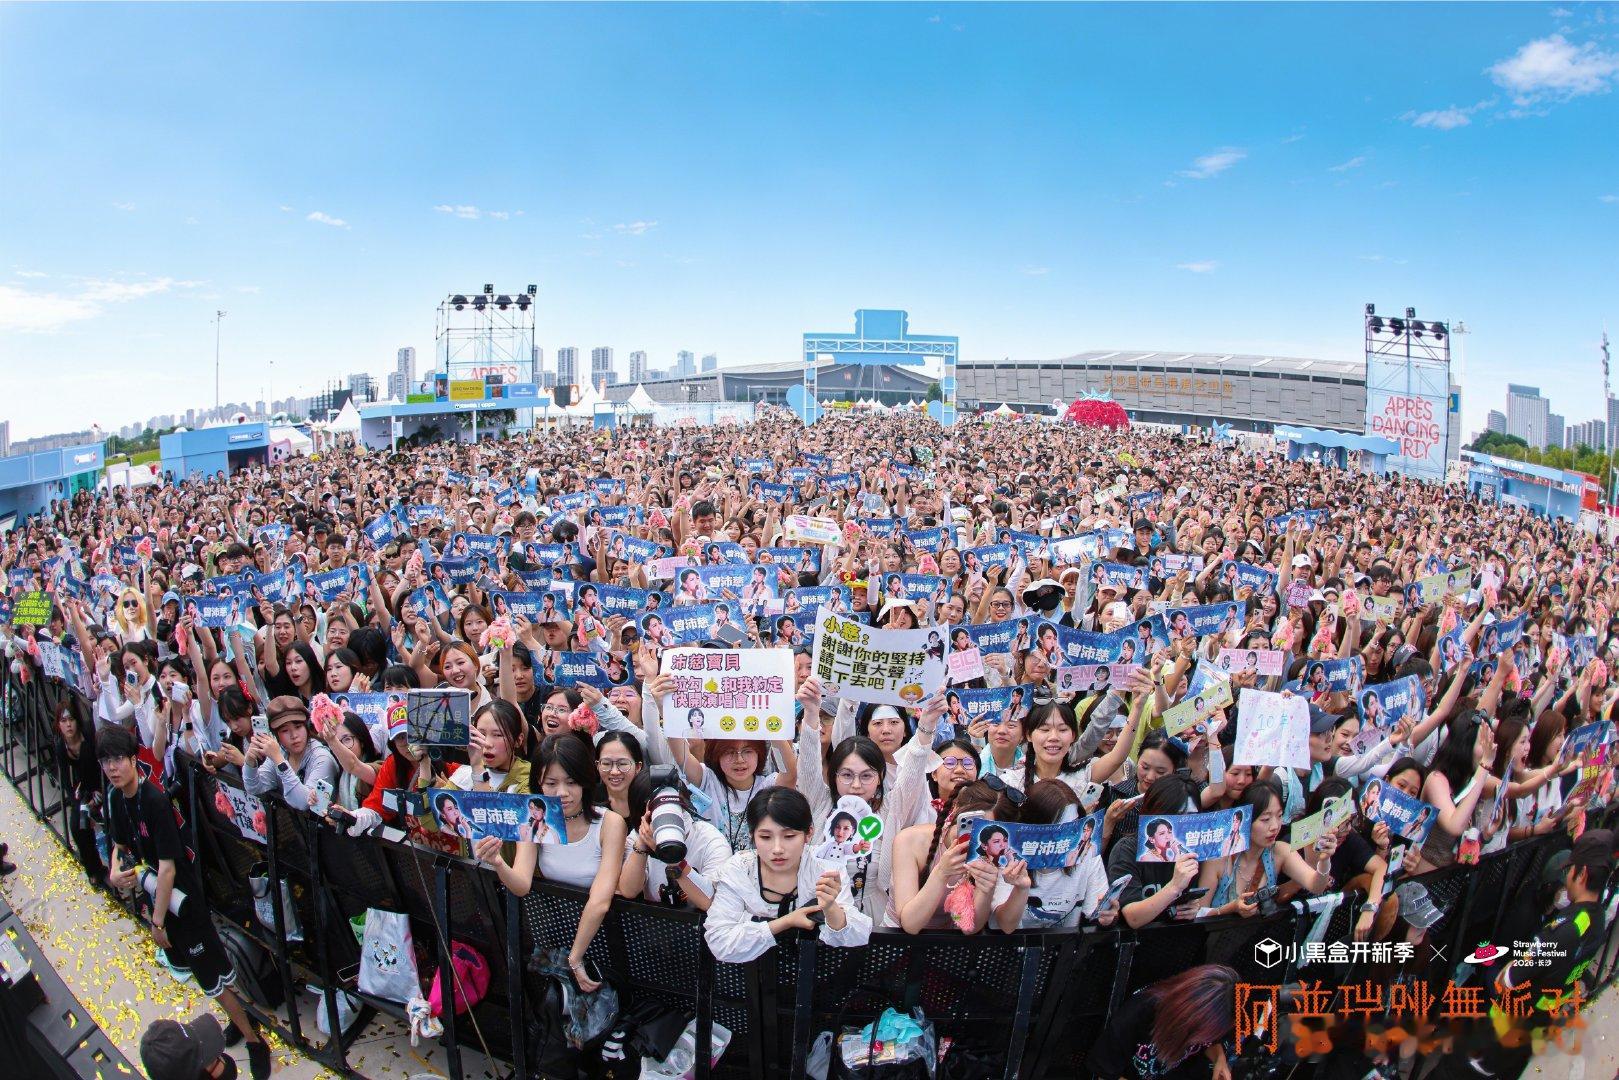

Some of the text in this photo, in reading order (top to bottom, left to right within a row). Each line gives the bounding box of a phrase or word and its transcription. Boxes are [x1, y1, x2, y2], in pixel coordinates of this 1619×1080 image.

[1385, 396, 1432, 421] APRÈS
[1373, 415, 1440, 442] DANCING
[1386, 436, 1431, 460] RTY
[709, 575, 744, 588] 曾沛慈
[511, 602, 537, 615] 曾沛慈
[606, 596, 638, 610] 曾沛慈
[672, 617, 710, 632] 曾沛慈
[823, 616, 869, 645] 小慈：
[979, 632, 1010, 646] 曾沛慈
[822, 634, 925, 666] 謝謝你的堅持
[1067, 642, 1110, 662] 曾沛慈
[671, 654, 740, 671] 沛慈寶貝
[819, 650, 905, 679] 請一直大聲
[721, 676, 783, 693] 和我約定
[817, 664, 897, 690] 唱下去吧！
[967, 699, 1003, 715] 曾沛慈
[471, 807, 519, 826] 曾沛慈
[1381, 800, 1412, 823] 曾沛慈
[1185, 829, 1224, 847] 曾沛慈
[1021, 839, 1070, 857] 曾沛慈
